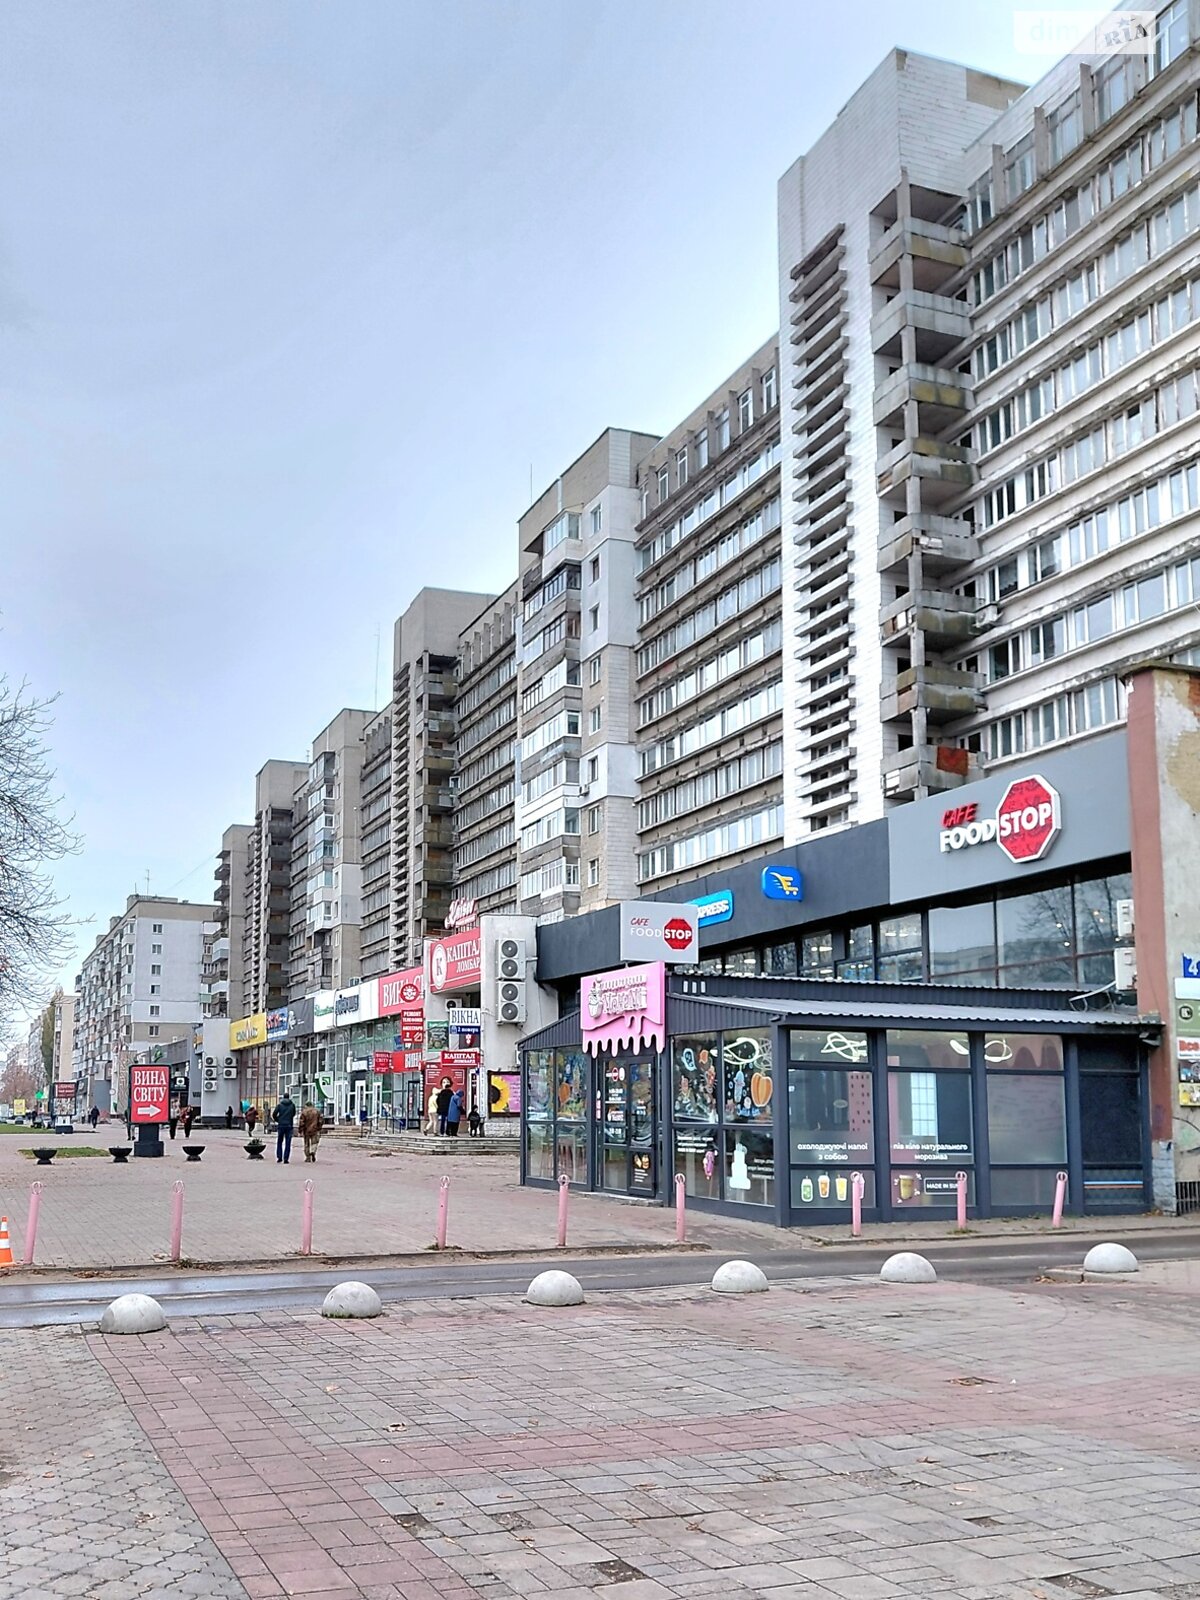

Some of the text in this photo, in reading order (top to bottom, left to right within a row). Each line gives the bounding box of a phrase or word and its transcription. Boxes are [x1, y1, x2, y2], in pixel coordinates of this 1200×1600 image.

[941, 802, 978, 829] CAFE
[940, 802, 1052, 853] FOOD STOP
[630, 917, 650, 926] CAFE
[630, 928, 692, 940] FOOD STOP
[456, 957, 481, 974] ЛОМБАР
[451, 1009, 480, 1024] ВІКНА
[134, 1070, 166, 1086] ВИНА
[133, 1087, 167, 1102] СВІТУ
[824, 1152, 848, 1160] собою
